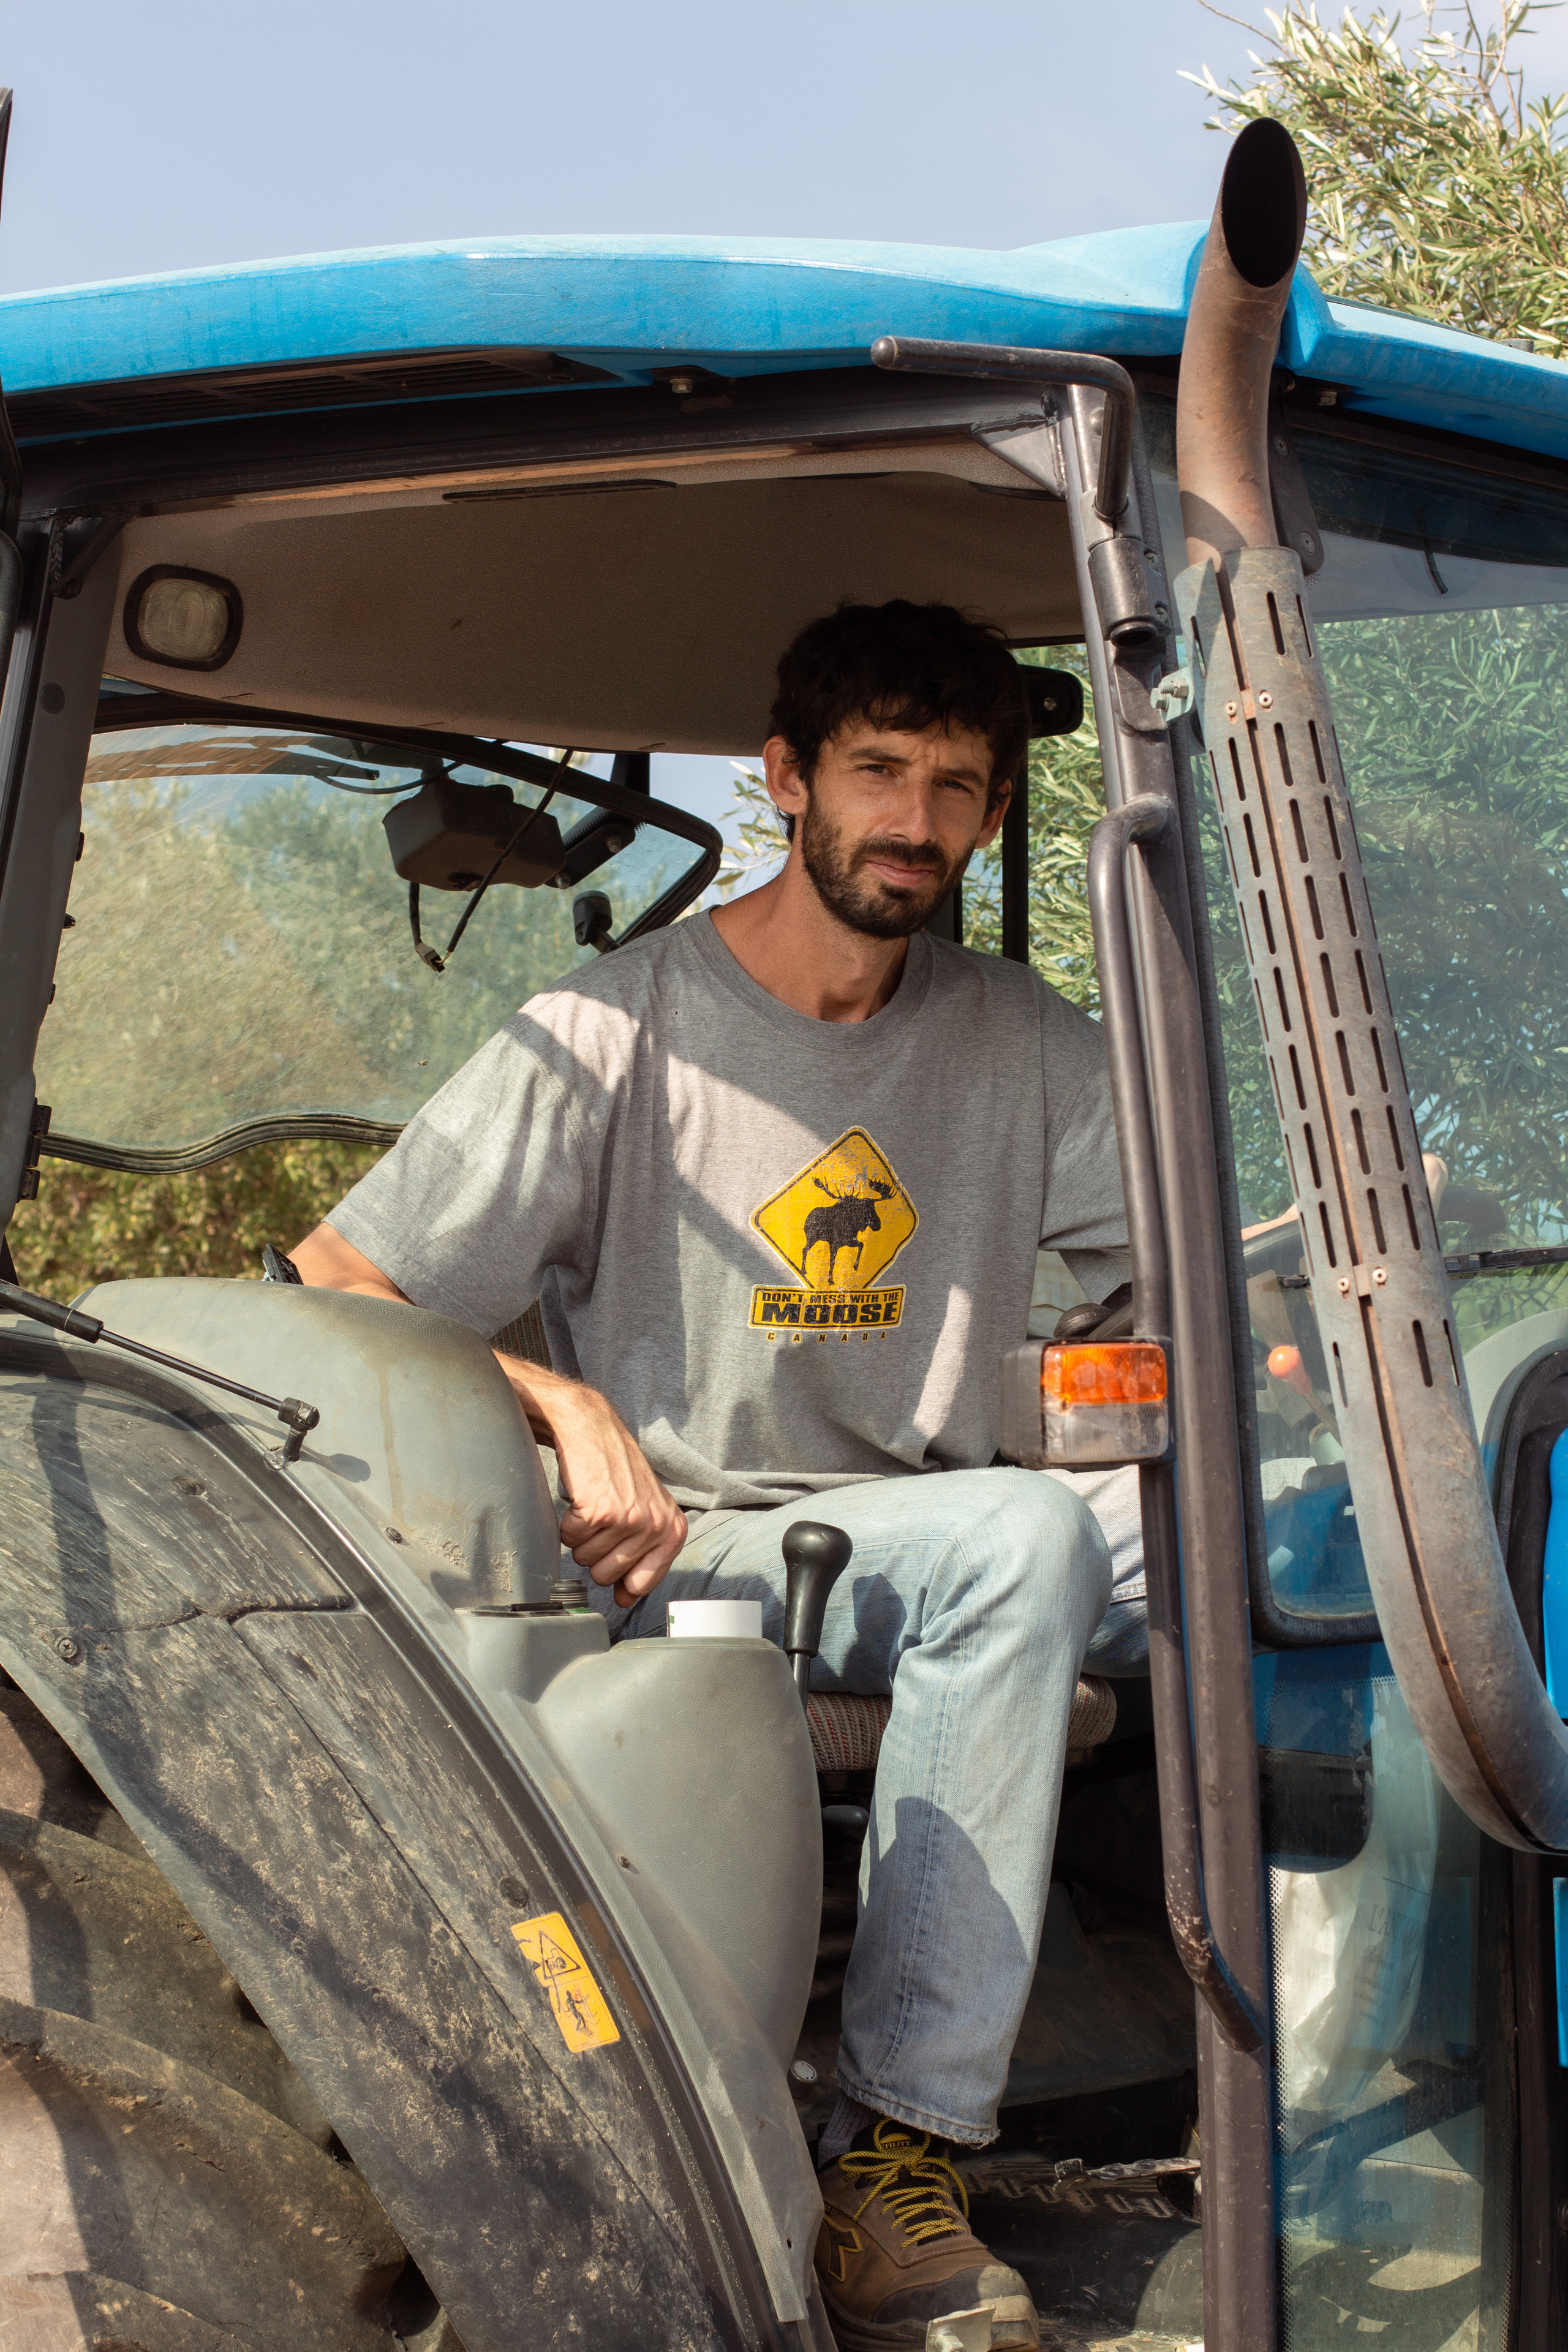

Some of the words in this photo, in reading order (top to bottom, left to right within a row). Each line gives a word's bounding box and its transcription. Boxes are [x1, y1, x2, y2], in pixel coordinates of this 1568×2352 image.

[762, 1292, 804, 1302] DON'T
[810, 1295, 845, 1303] MESS
[850, 1294, 878, 1303] WITH
[883, 1292, 899, 1302] THE
[761, 1302, 897, 1324] MOOSE
[767, 1332, 886, 1342] CANADA
